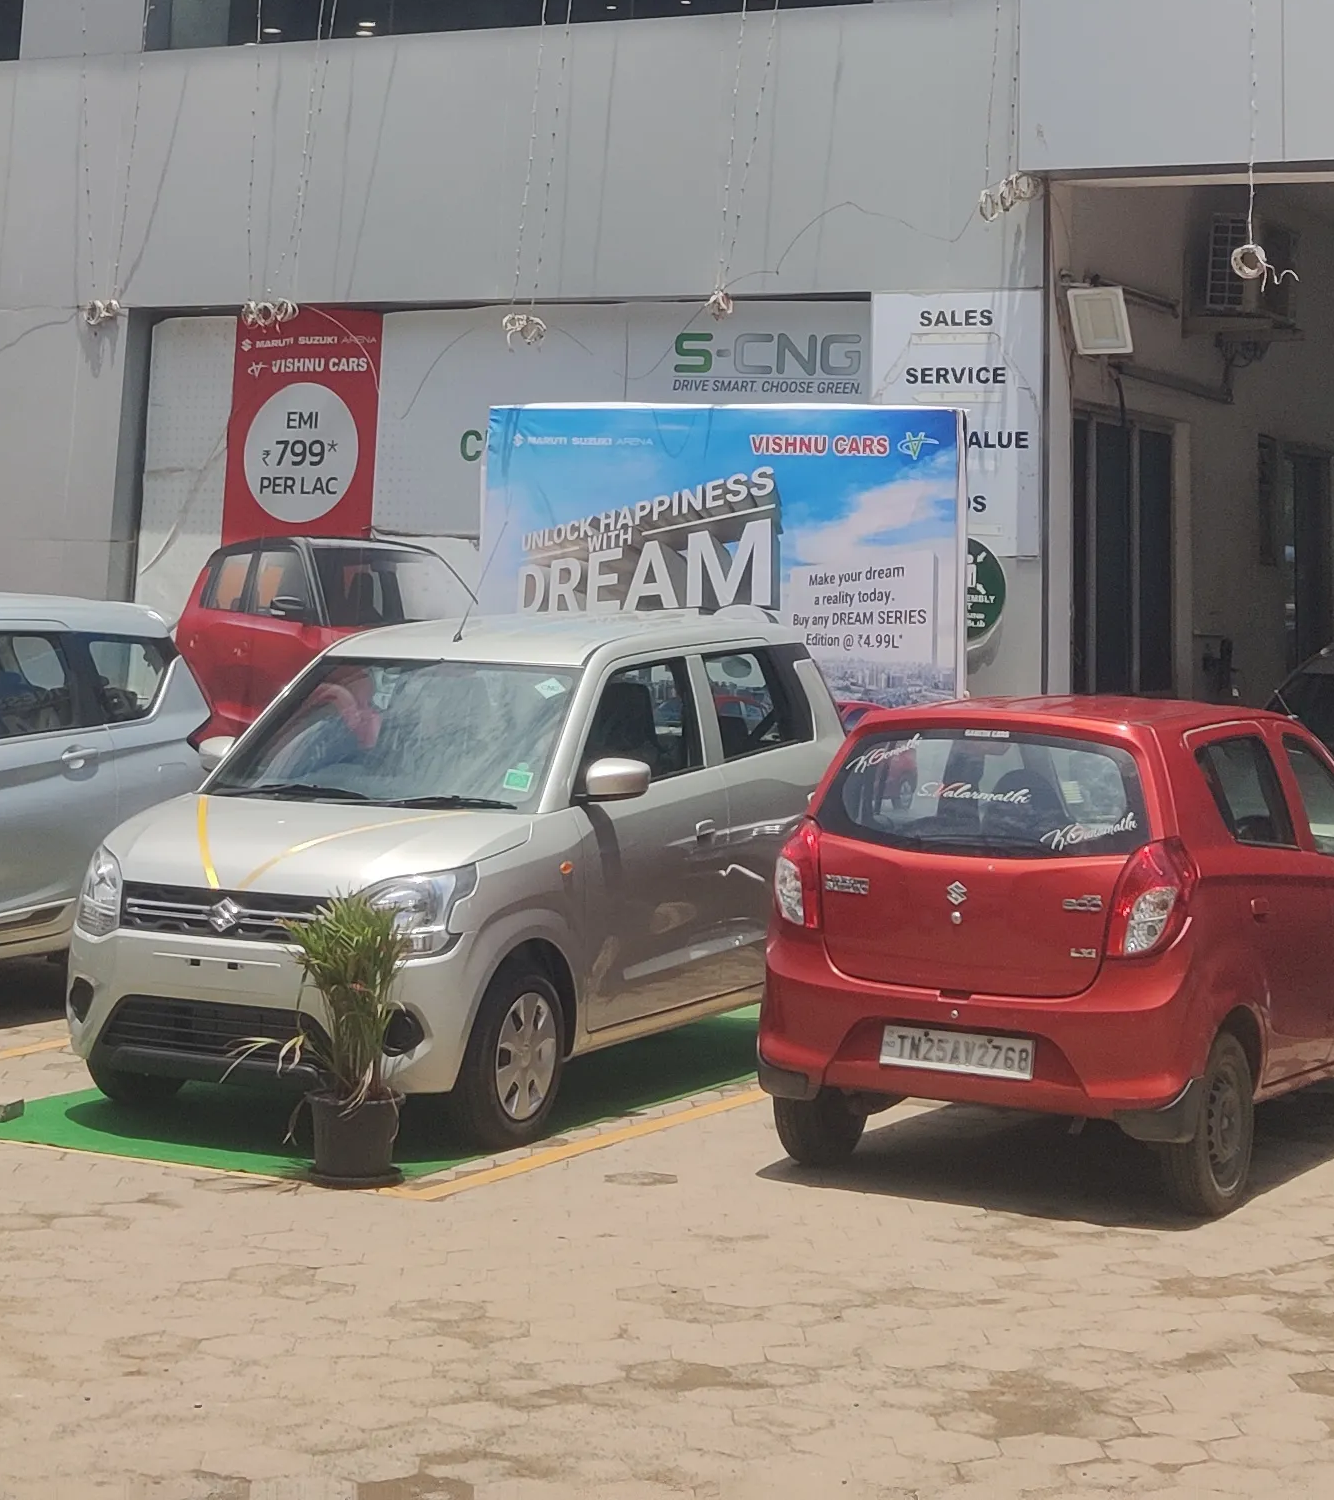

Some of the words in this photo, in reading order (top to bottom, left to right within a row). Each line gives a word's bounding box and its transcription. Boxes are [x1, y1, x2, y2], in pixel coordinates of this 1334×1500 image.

[920, 309, 993, 328] SALES
[256, 337, 294, 348] MARUTI
[298, 336, 337, 345] SUZUKI
[341, 336, 377, 344] ARENA
[674, 332, 862, 377] S-CNG
[271, 358, 325, 373] VISHNU
[329, 357, 368, 372] CARS
[905, 365, 1007, 385] SERVICE
[672, 380, 710, 393] DRIVE
[712, 380, 758, 394] SMART.
[761, 380, 815, 394] CHOOSE
[817, 380, 863, 396] GREEN.
[286, 411, 319, 430] EMI
[749, 433, 829, 456] VISHNU
[833, 433, 890, 457] CARS
[967, 431, 1030, 450] ALUE
[259, 476, 296, 495] PER
[300, 476, 338, 495] LAC
[521, 515, 593, 551] UNLOCK
[599, 466, 775, 532] HAPPINESS
[587, 527, 633, 551] WITH
[519, 518, 773, 613] DREAM
[808, 572, 836, 586] Make
[837, 569, 863, 589] your
[865, 564, 906, 581] dream
[814, 595, 820, 605] a
[821, 591, 856, 607] reality
[857, 588, 896, 605] today.
[792, 613, 810, 628] Buy
[811, 614, 830, 629] any
[832, 611, 874, 626] DREAM
[877, 609, 928, 625] SERIES
[805, 632, 840, 647] Edition
[842, 634, 855, 651] @
